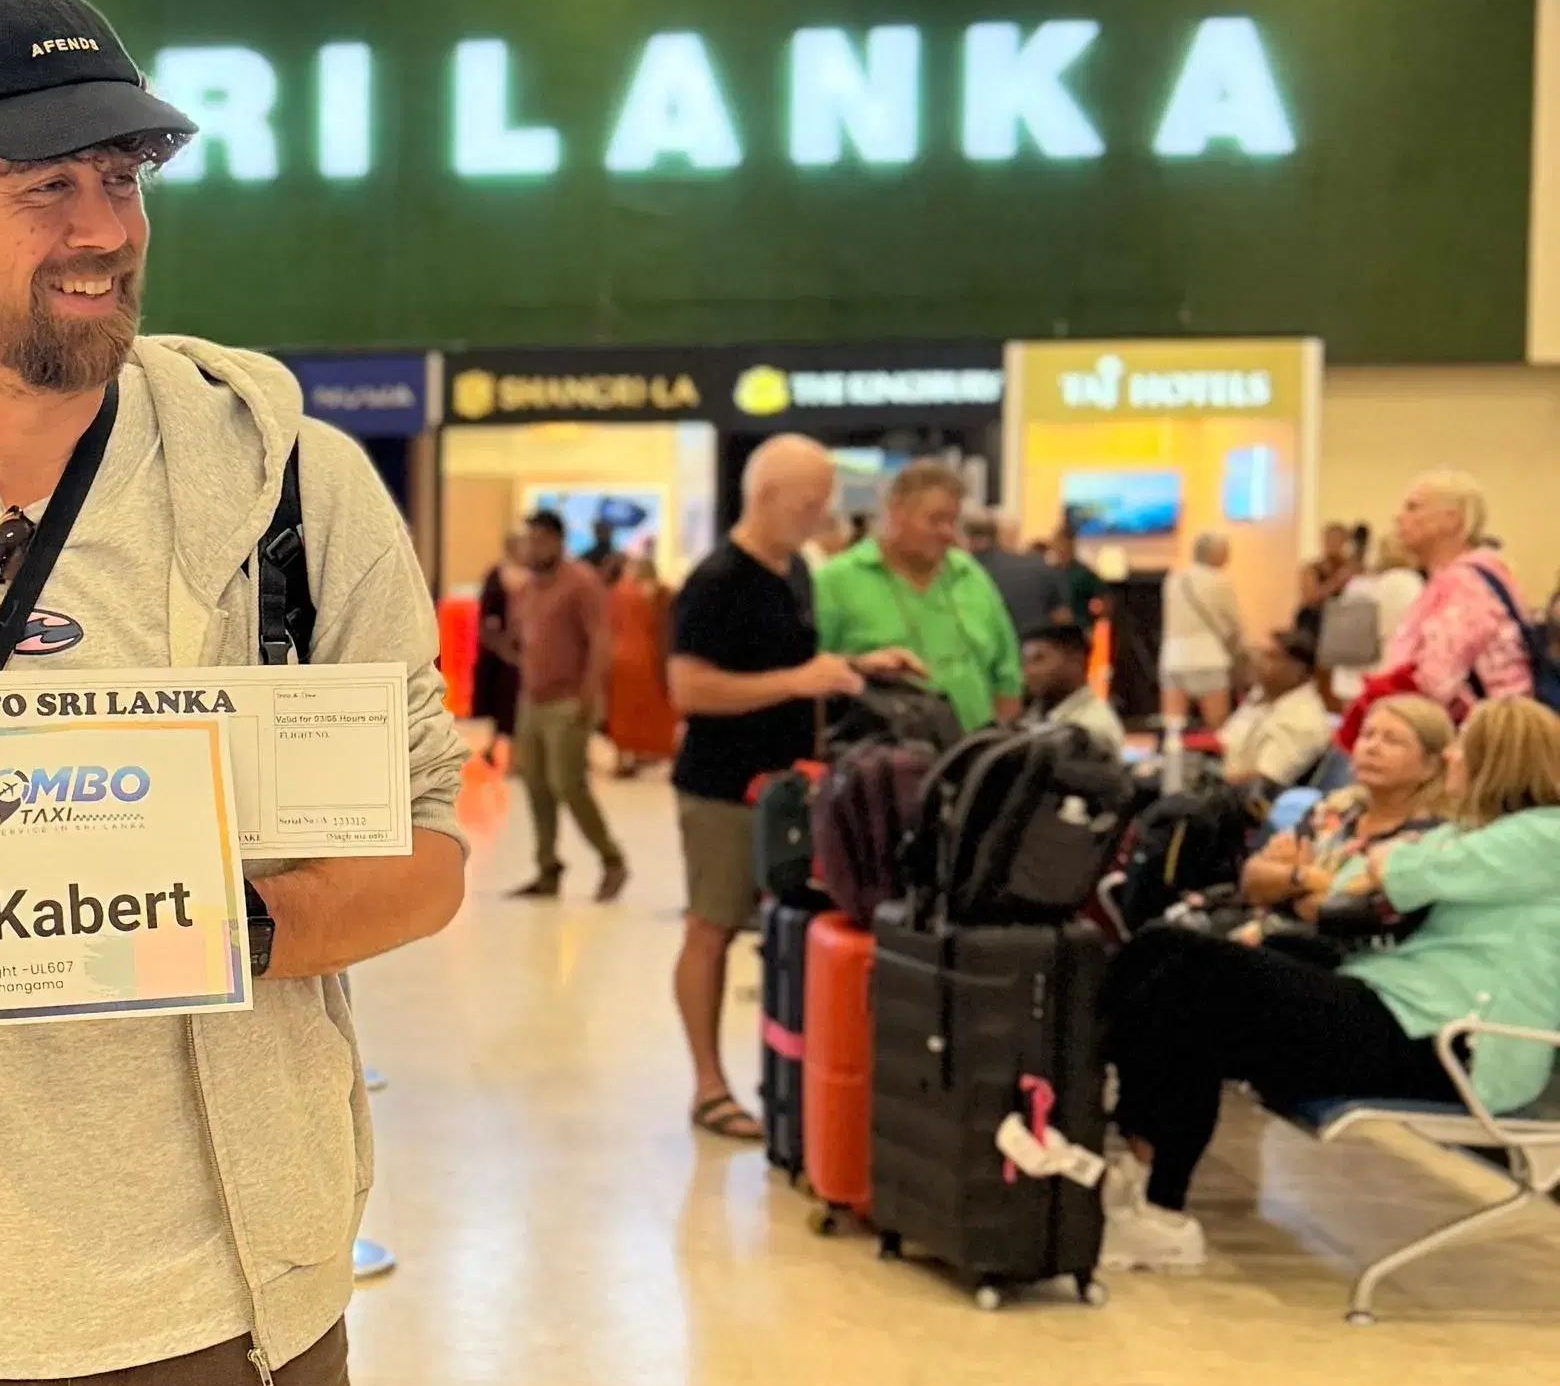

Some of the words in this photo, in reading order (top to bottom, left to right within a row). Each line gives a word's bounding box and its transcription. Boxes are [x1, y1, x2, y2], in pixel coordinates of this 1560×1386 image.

[31, 37, 100, 58] AFENDS
[153, 41, 372, 181] RI
[452, 15, 1297, 179] LANKA
[36, 691, 97, 717] SRI
[106, 689, 237, 715] LANKA
[275, 714, 297, 724] Valid
[299, 714, 312, 723] for
[339, 713, 366, 723] Hours
[368, 713, 388, 725] only
[21, 807, 74, 825] TAXI
